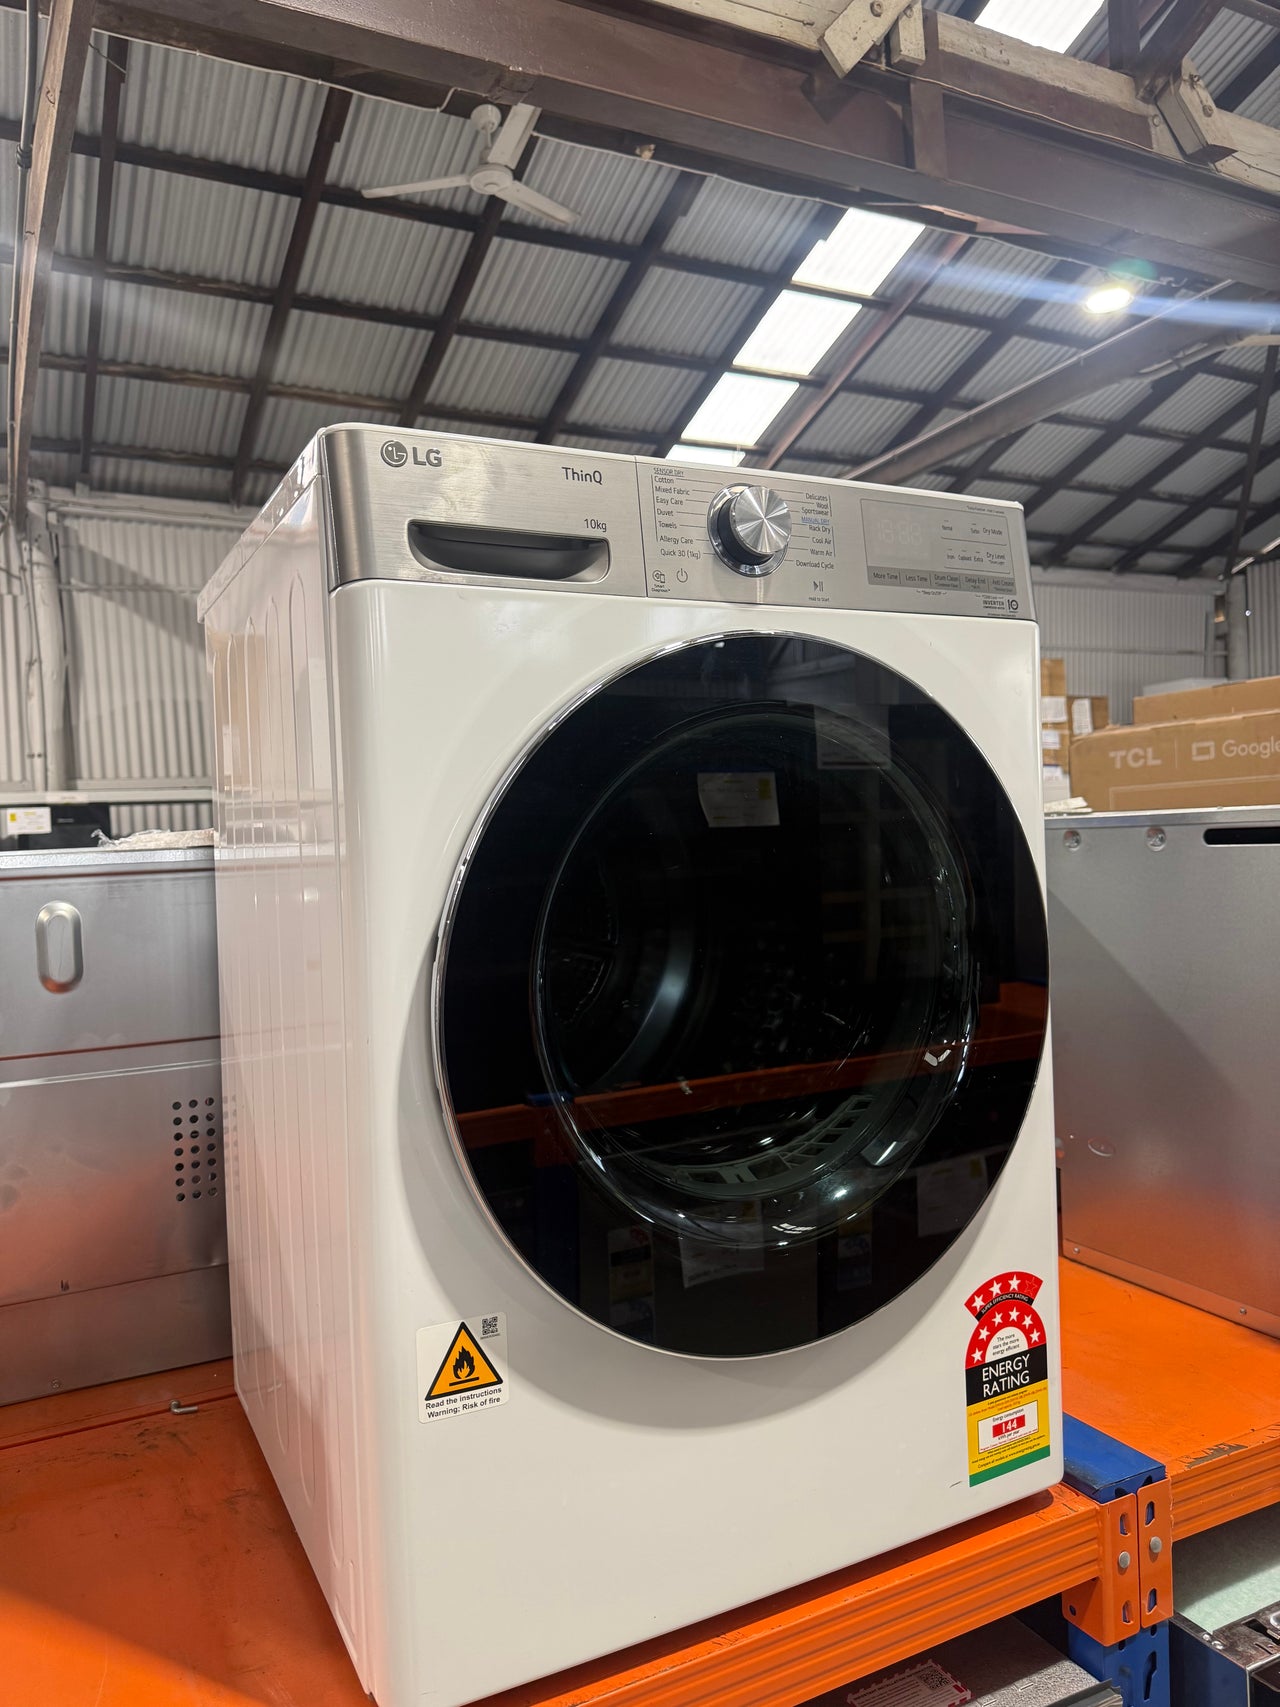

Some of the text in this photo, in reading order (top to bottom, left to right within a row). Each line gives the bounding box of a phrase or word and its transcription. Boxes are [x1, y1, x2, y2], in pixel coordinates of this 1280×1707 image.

[412, 446, 443, 468] LG
[561, 466, 603, 485] ThinQ
[653, 467, 685, 477] SENSOR DRY
[654, 475, 675, 484] Cotton
[655, 485, 690, 496] Mixed Fabric
[656, 496, 684, 506] Easy Care
[805, 492, 828, 502] Delicates
[657, 508, 674, 517] Duvet
[801, 507, 829, 516] Sportswear
[658, 520, 677, 529] Towels
[801, 516, 818, 524] MANUAL
[584, 518, 607, 533] 10kg
[808, 524, 831, 534] Rack Dry
[982, 527, 1003, 536] Dry Mode
[659, 535, 694, 545] Allergy Care
[660, 549, 676, 557] Quick
[686, 551, 701, 560] (1kg)
[810, 548, 825, 556] Warm
[986, 551, 1005, 560] Dry Level
[795, 559, 835, 570] Download Cycle
[873, 572, 898, 581] More Time
[917, 575, 928, 583] Time
[934, 574, 946, 582] Drum
[965, 577, 977, 585] Delay
[1109, 747, 1163, 769] TCL
[981, 1293, 1029, 1314] SUPER EFFICIENCY RATING
[982, 1353, 1030, 1382] ENERGY
[982, 1370, 1030, 1399] RATING
[425, 1387, 502, 1410] Read the instructions
[462, 1401, 478, 1411] Risk
[479, 1398, 488, 1407] of
[488, 1396, 501, 1405] fire
[1004, 1408, 1024, 1419] consumption
[1002, 1419, 1018, 1433] 144
